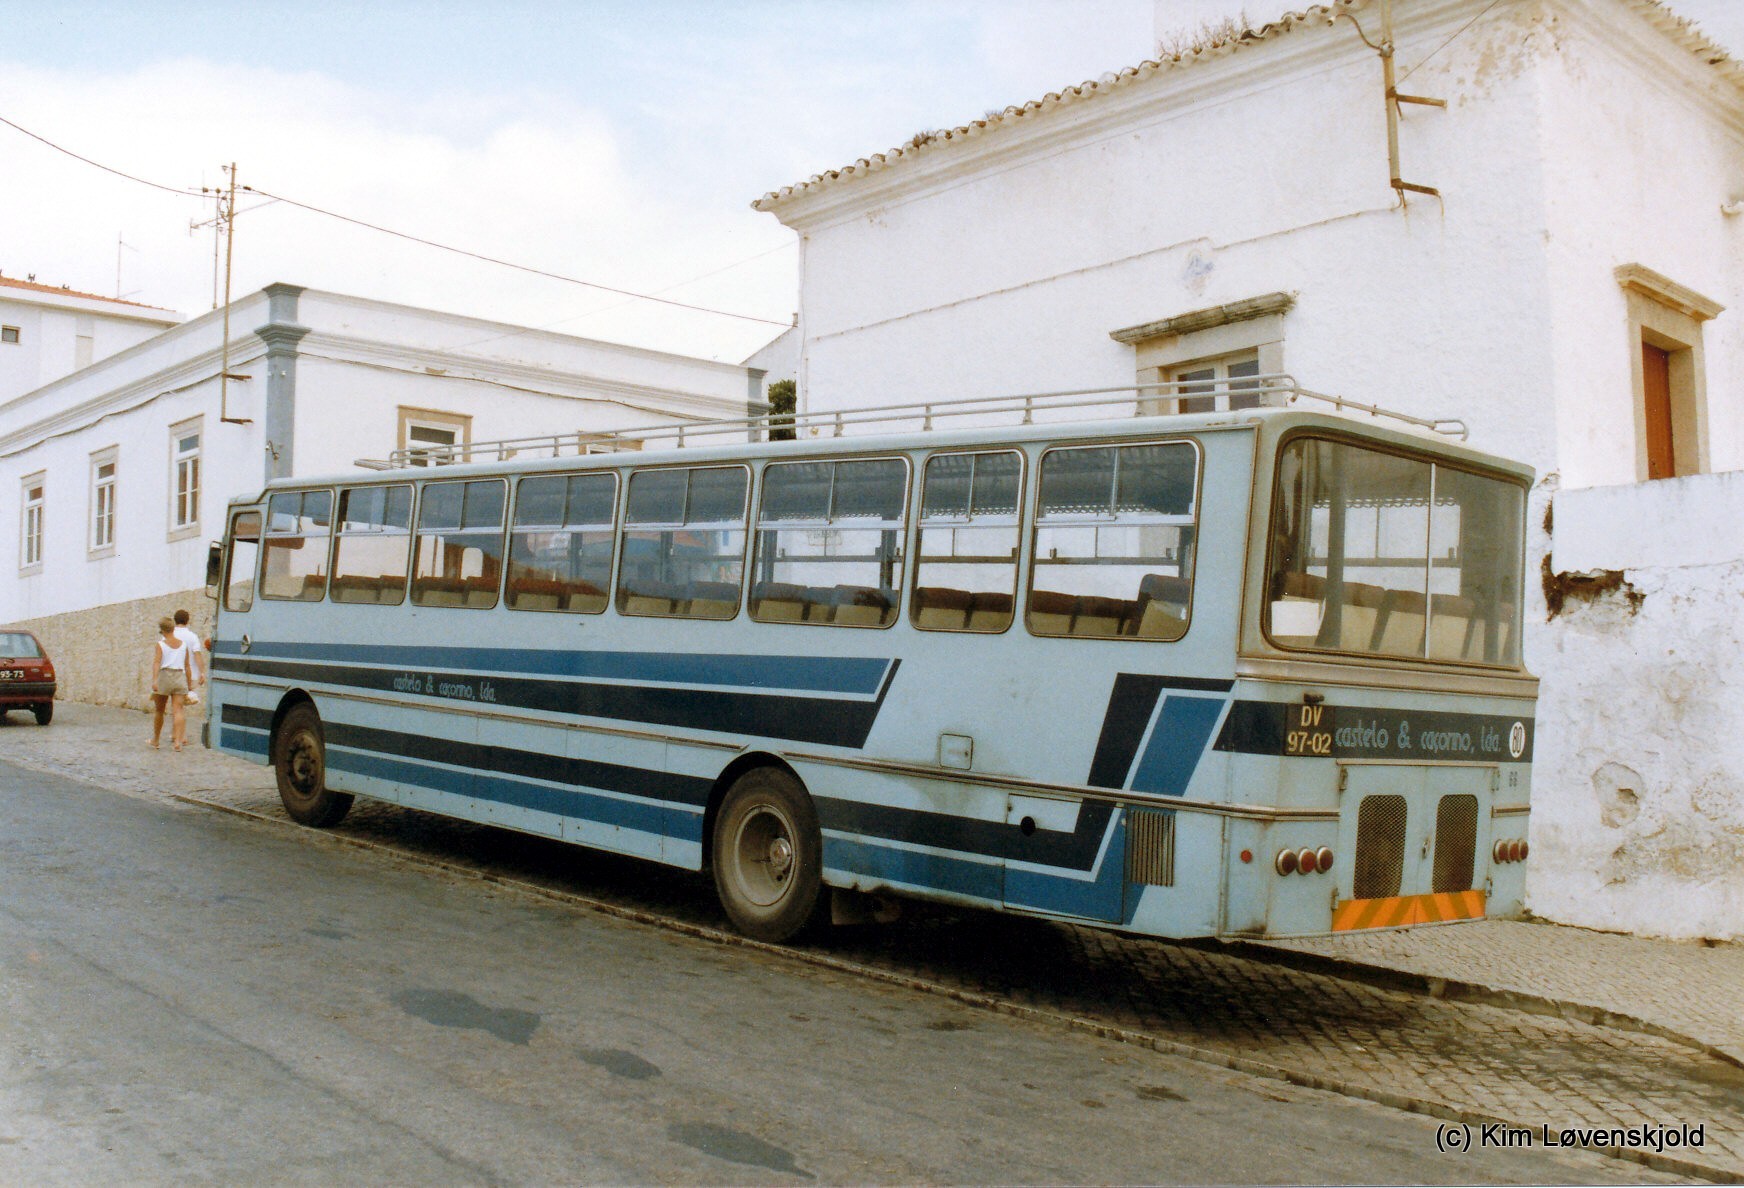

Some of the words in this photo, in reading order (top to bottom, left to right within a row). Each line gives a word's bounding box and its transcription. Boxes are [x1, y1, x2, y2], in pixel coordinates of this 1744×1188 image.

[425, 674, 434, 694] &
[1301, 705, 1323, 727] DV
[1287, 731, 1332, 754] 97-02
[1397, 720, 1411, 749] &
